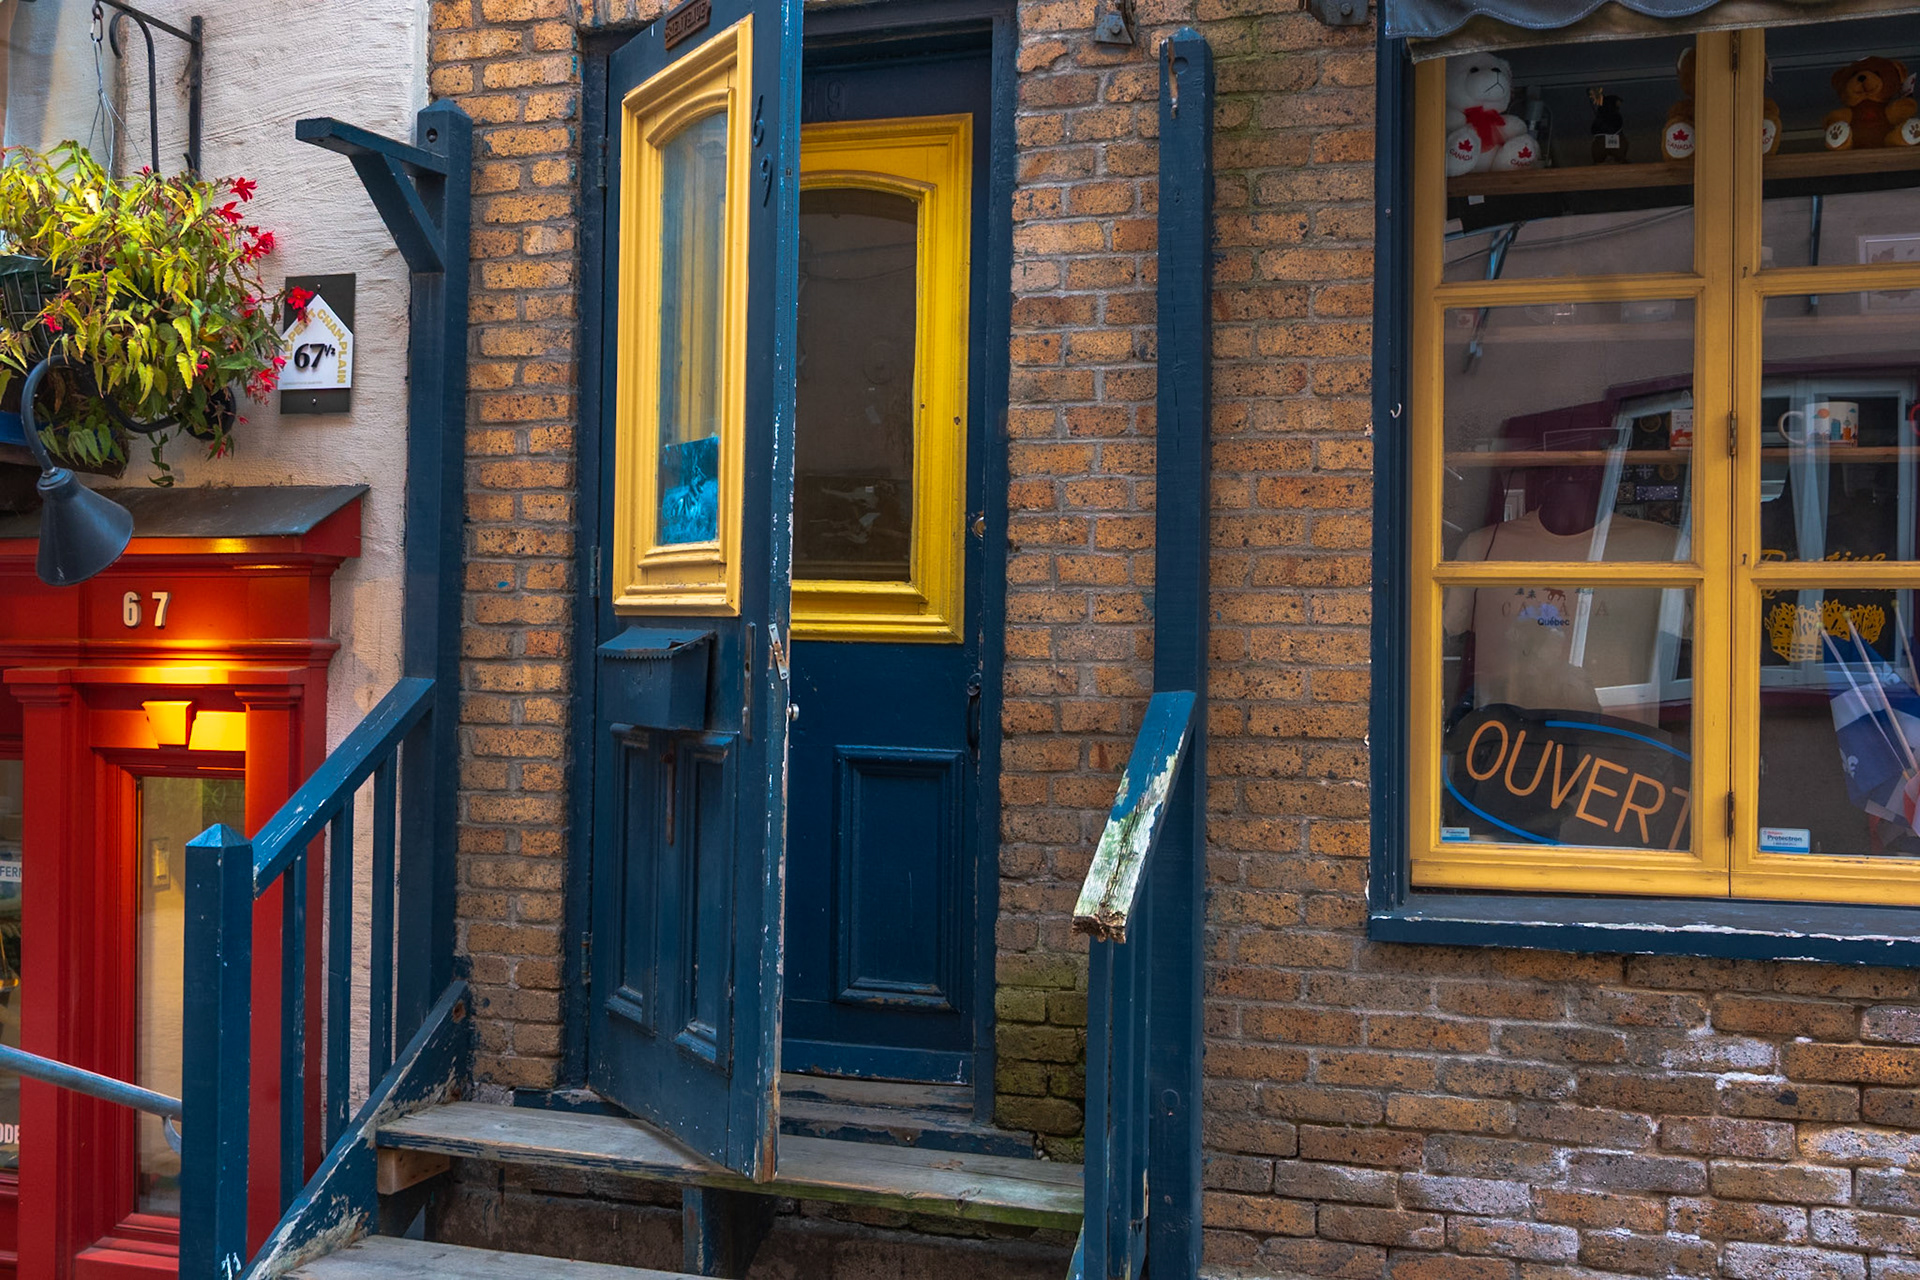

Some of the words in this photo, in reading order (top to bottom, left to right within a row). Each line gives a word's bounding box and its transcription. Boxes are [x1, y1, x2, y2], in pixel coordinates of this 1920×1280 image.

[317, 308, 348, 384] CHAMPLAIN
[123, 591, 171, 627] 67
[1537, 617, 1570, 626] Québec
[1466, 720, 1691, 850] OUVERT
